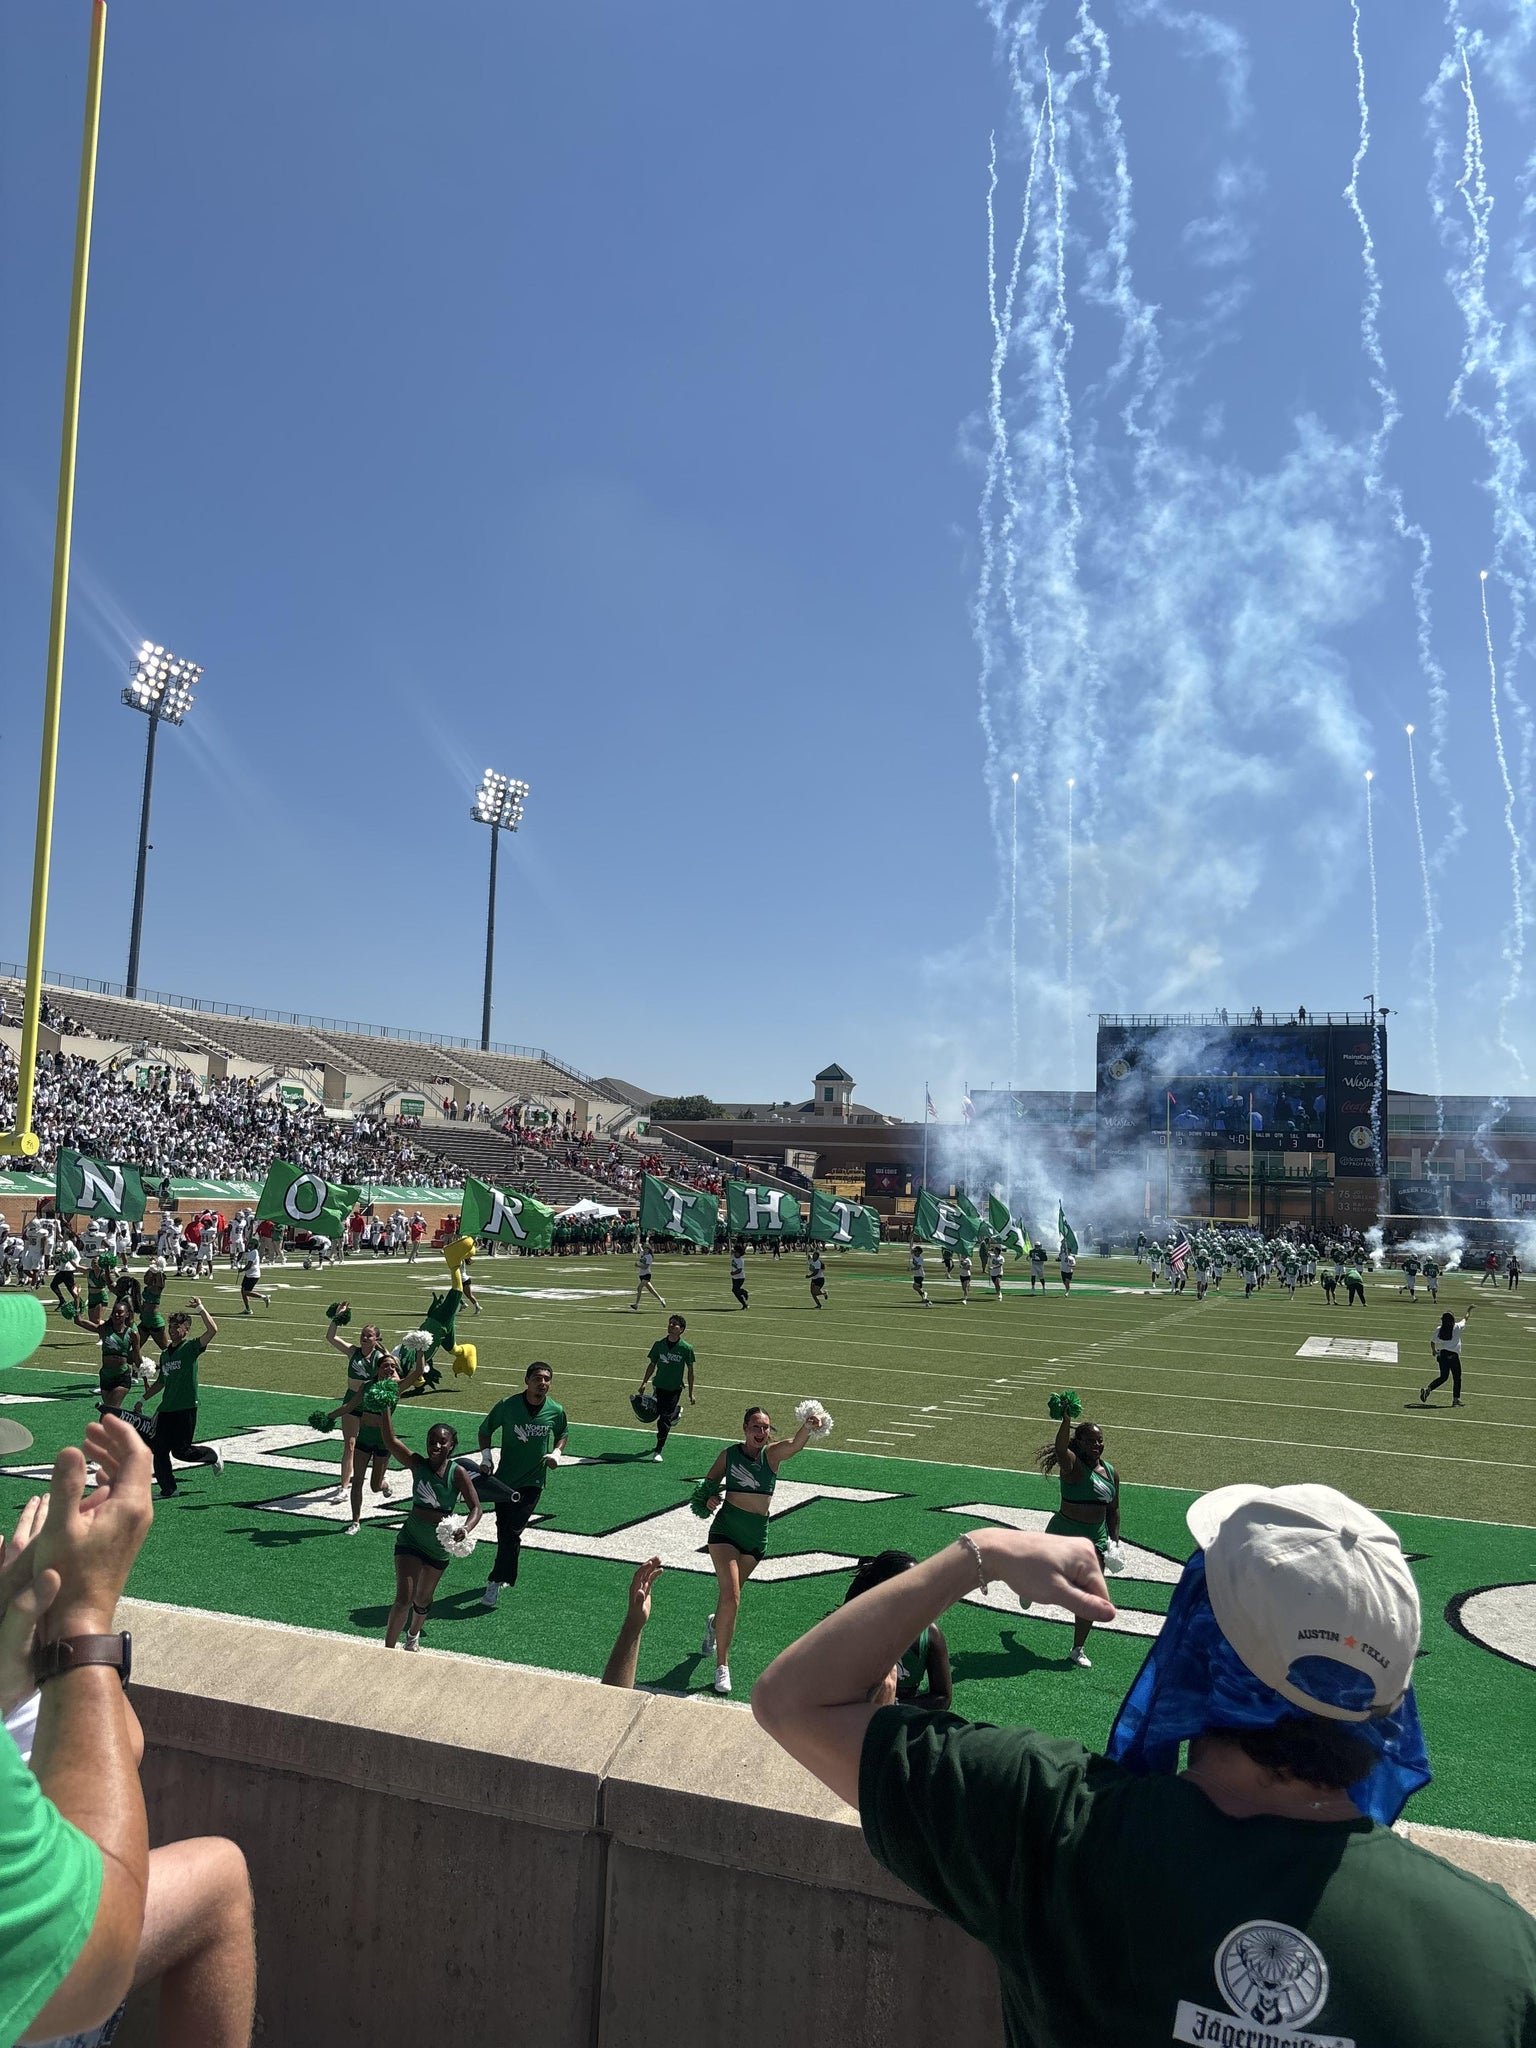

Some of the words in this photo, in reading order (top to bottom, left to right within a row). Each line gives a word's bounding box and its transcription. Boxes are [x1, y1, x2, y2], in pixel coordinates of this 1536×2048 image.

[1342, 1073, 1379, 1090] WinSta
[1160, 1136, 1166, 1145] 0
[1178, 1137, 1183, 1146] 3
[1292, 1140, 1298, 1148] 3
[1317, 1139, 1324, 1149] 0
[76, 1156, 126, 1214] N
[284, 1173, 328, 1221] O
[1338, 1190, 1350, 1199] 75
[481, 1186, 529, 1240] R
[662, 1186, 699, 1235] T
[744, 1187, 786, 1231] H
[830, 1201, 864, 1243] T
[931, 1201, 962, 1246] E
[1297, 1629, 1340, 1642] AUSTIN
[1361, 1643, 1391, 1669] TEXAS
[1192, 2011, 1332, 2048] Jägerme
